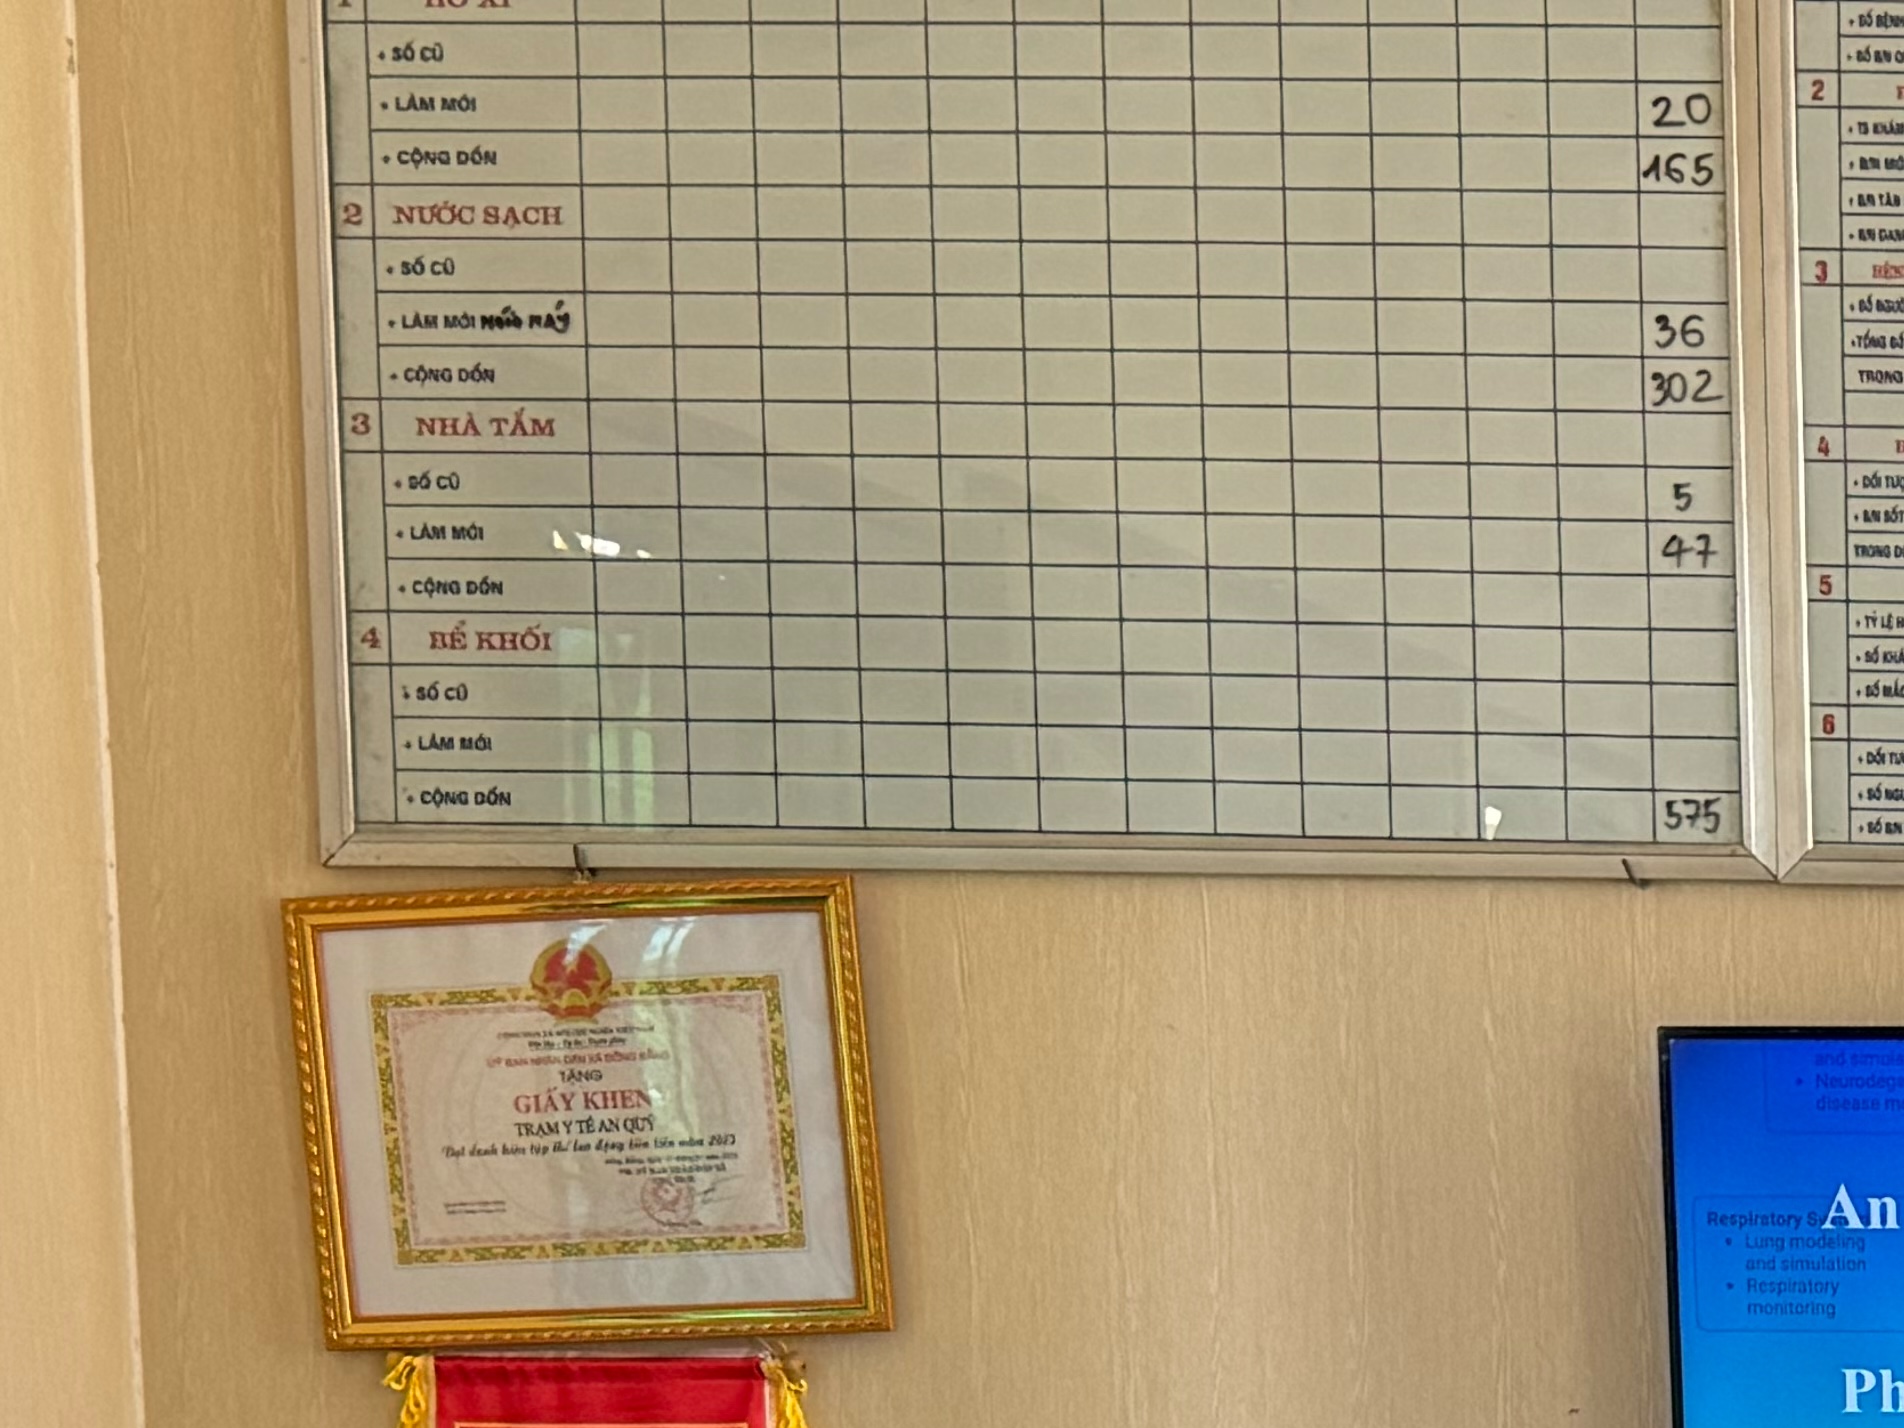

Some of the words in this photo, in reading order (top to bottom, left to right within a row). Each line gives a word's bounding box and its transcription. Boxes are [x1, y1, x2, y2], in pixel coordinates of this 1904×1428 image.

[1652, 94, 1712, 128] 20
[1642, 152, 1714, 187] 165
[342, 203, 363, 227] 2
[393, 200, 475, 226] NƯỚC
[482, 204, 563, 230] SẠCH
[1654, 312, 1706, 350] 36
[1650, 369, 1723, 405] 302
[350, 414, 372, 437] 3
[415, 411, 481, 437] NHÀ
[489, 406, 556, 437] TẮM
[1673, 482, 1694, 513] 5
[1660, 533, 1718, 569] 47
[1663, 798, 1722, 833] 575
[513, 1086, 575, 1115] GIẤY
[583, 1088, 652, 1111] KHEN
[1821, 1183, 1900, 1230] An
